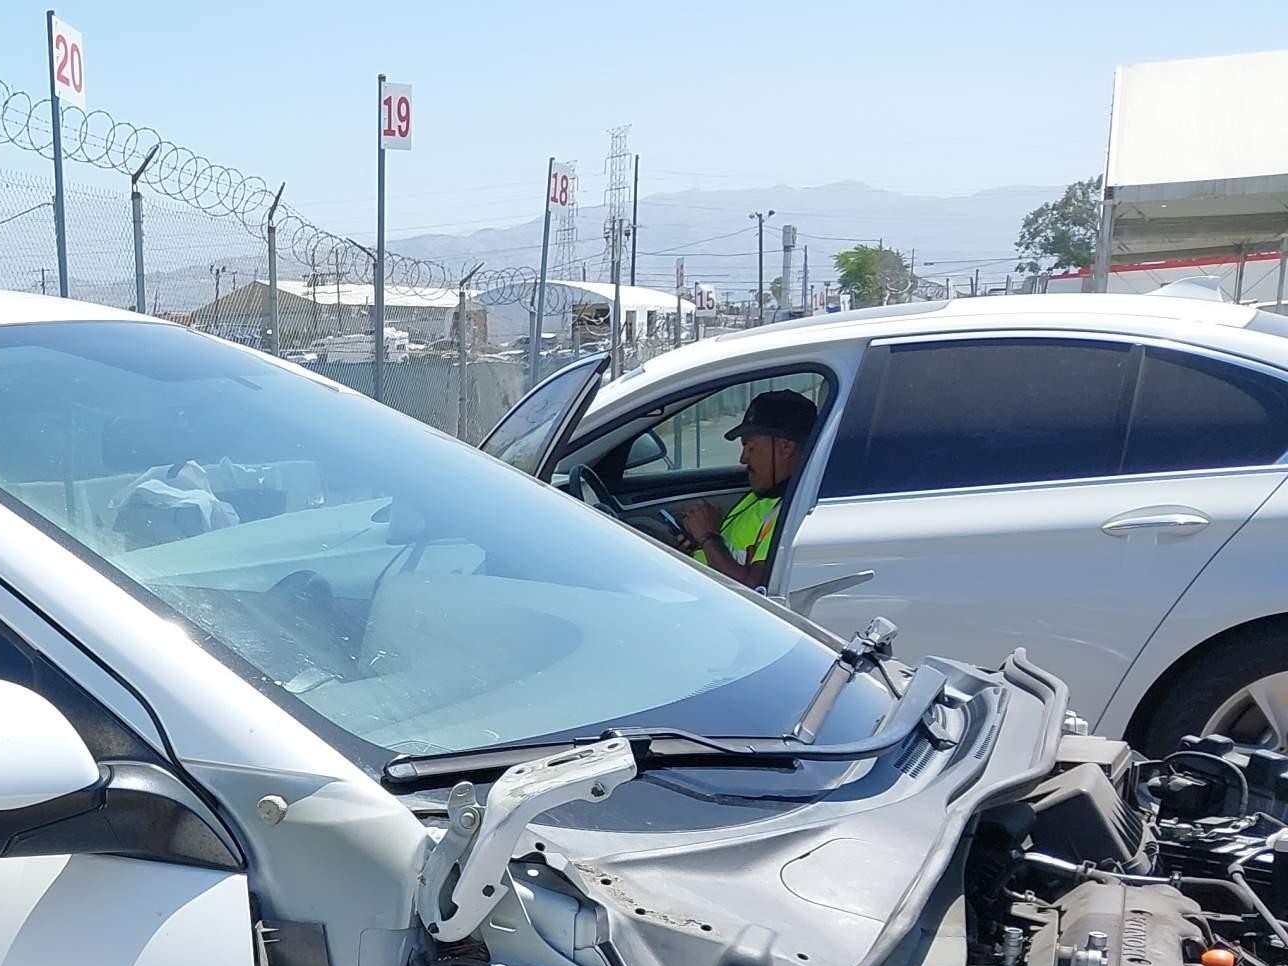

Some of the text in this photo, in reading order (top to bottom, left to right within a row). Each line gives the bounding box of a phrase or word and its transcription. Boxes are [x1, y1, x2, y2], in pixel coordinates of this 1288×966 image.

[55, 33, 83, 94] 20
[383, 95, 410, 138] 19
[551, 172, 569, 207] 18
[696, 290, 715, 310] 15
[1121, 917, 1147, 959] HONDA
